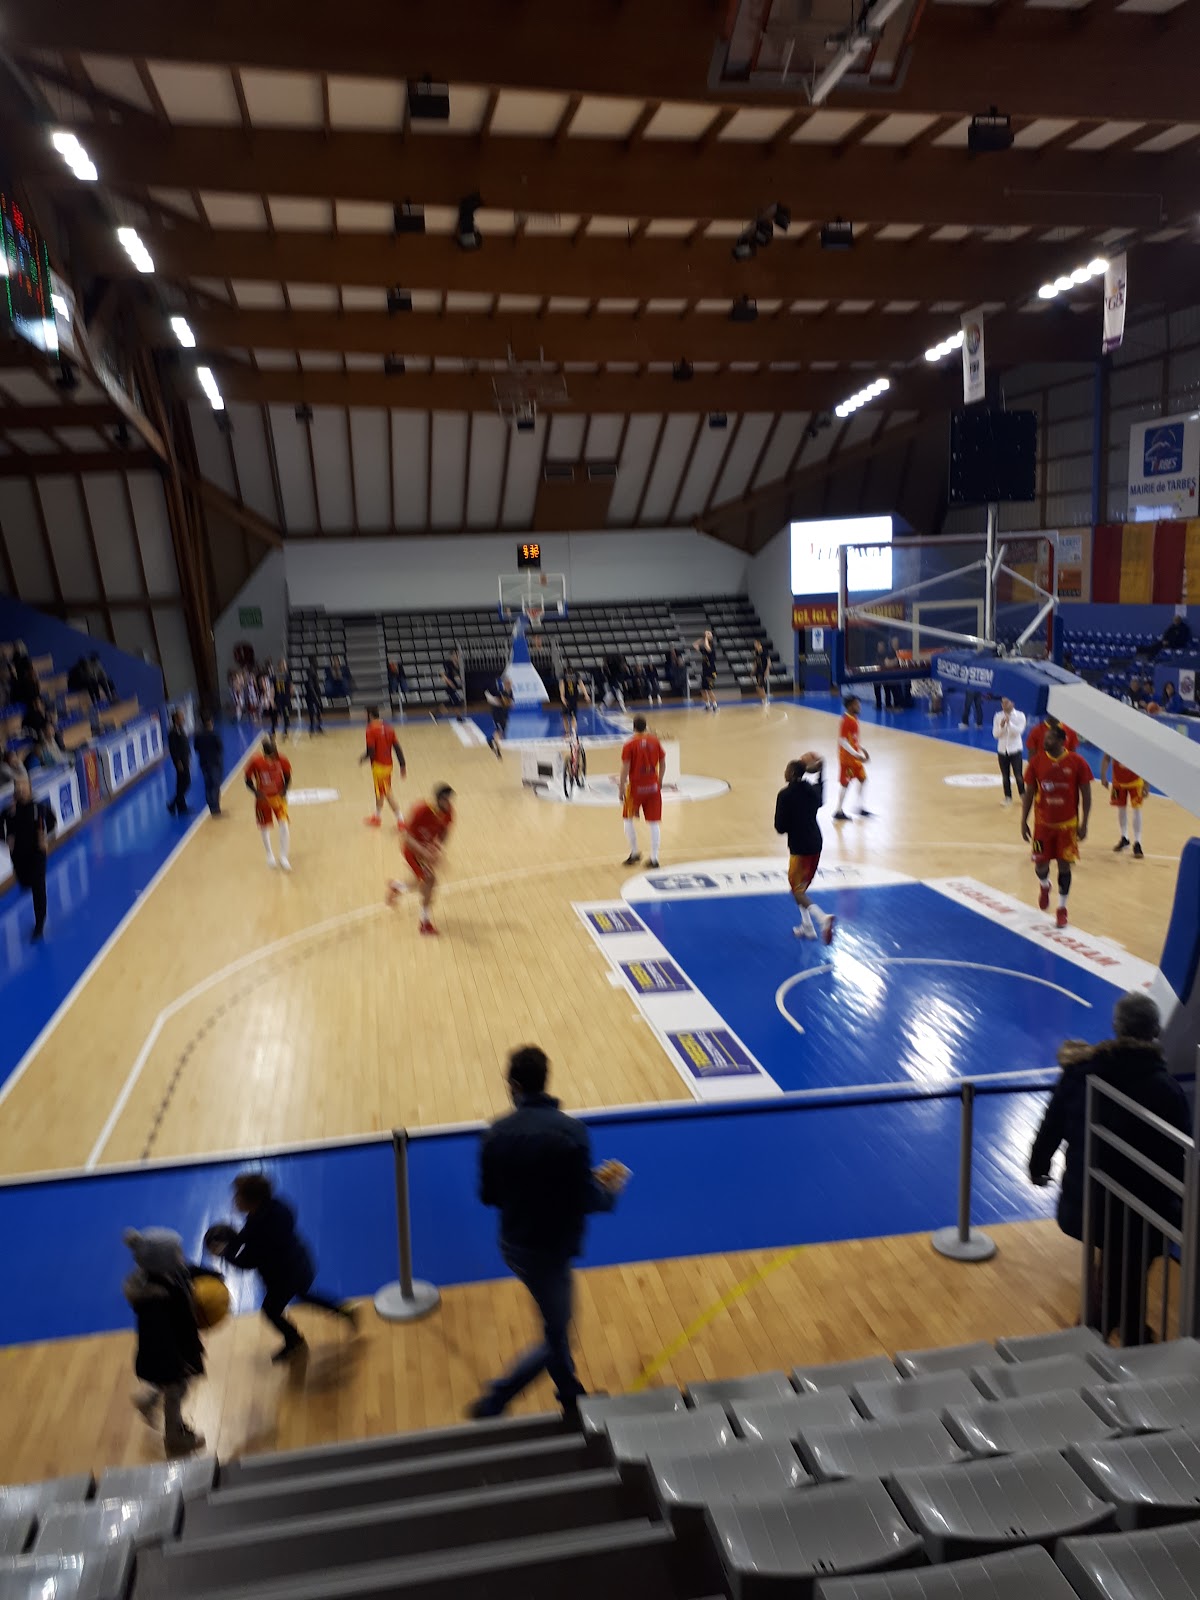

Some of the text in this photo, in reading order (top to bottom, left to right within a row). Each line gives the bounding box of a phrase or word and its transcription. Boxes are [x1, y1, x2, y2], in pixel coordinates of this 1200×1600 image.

[1130, 477, 1197, 496] MAIRIE de TARBES
